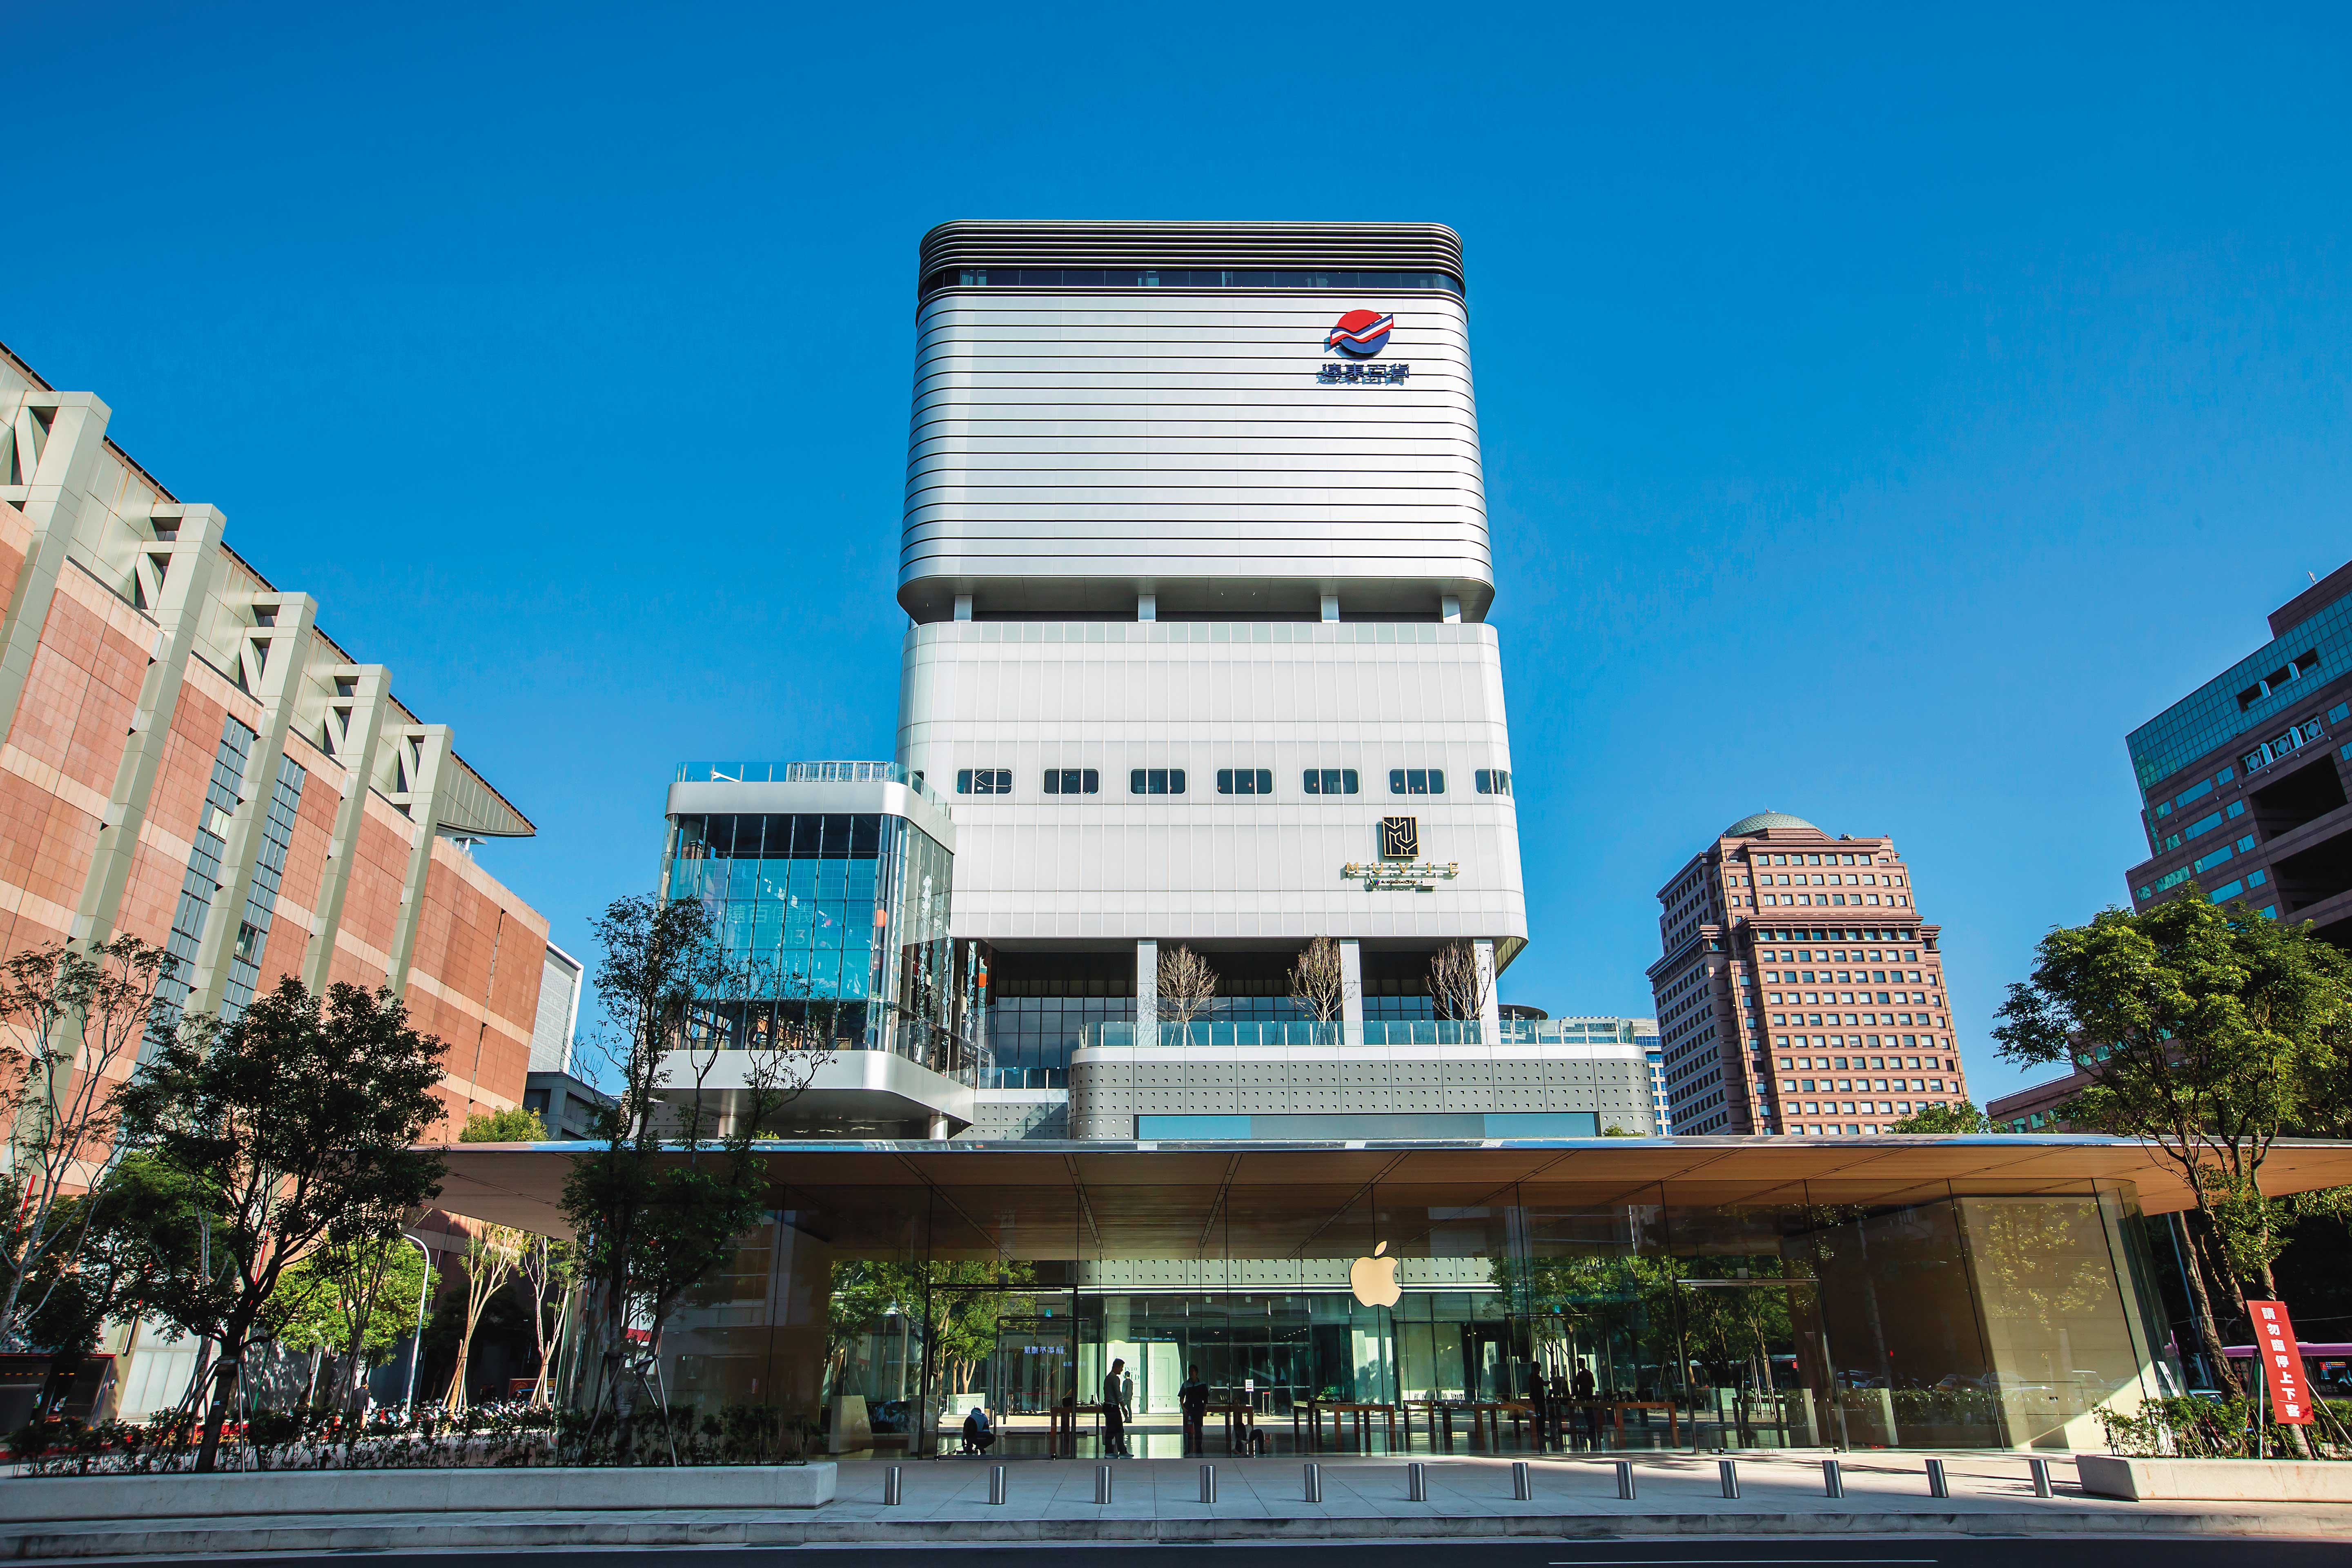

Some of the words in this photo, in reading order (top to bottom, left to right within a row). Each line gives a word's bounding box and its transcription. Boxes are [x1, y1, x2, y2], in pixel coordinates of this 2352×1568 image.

[1322, 363, 1410, 378] 遠東百貨
[1346, 862, 1459, 873] MUVIE
[726, 903, 815, 924] 遠百信義
[771, 929, 805, 944] A13
[2261, 1307, 2300, 1417] 請勿臨停上下客
